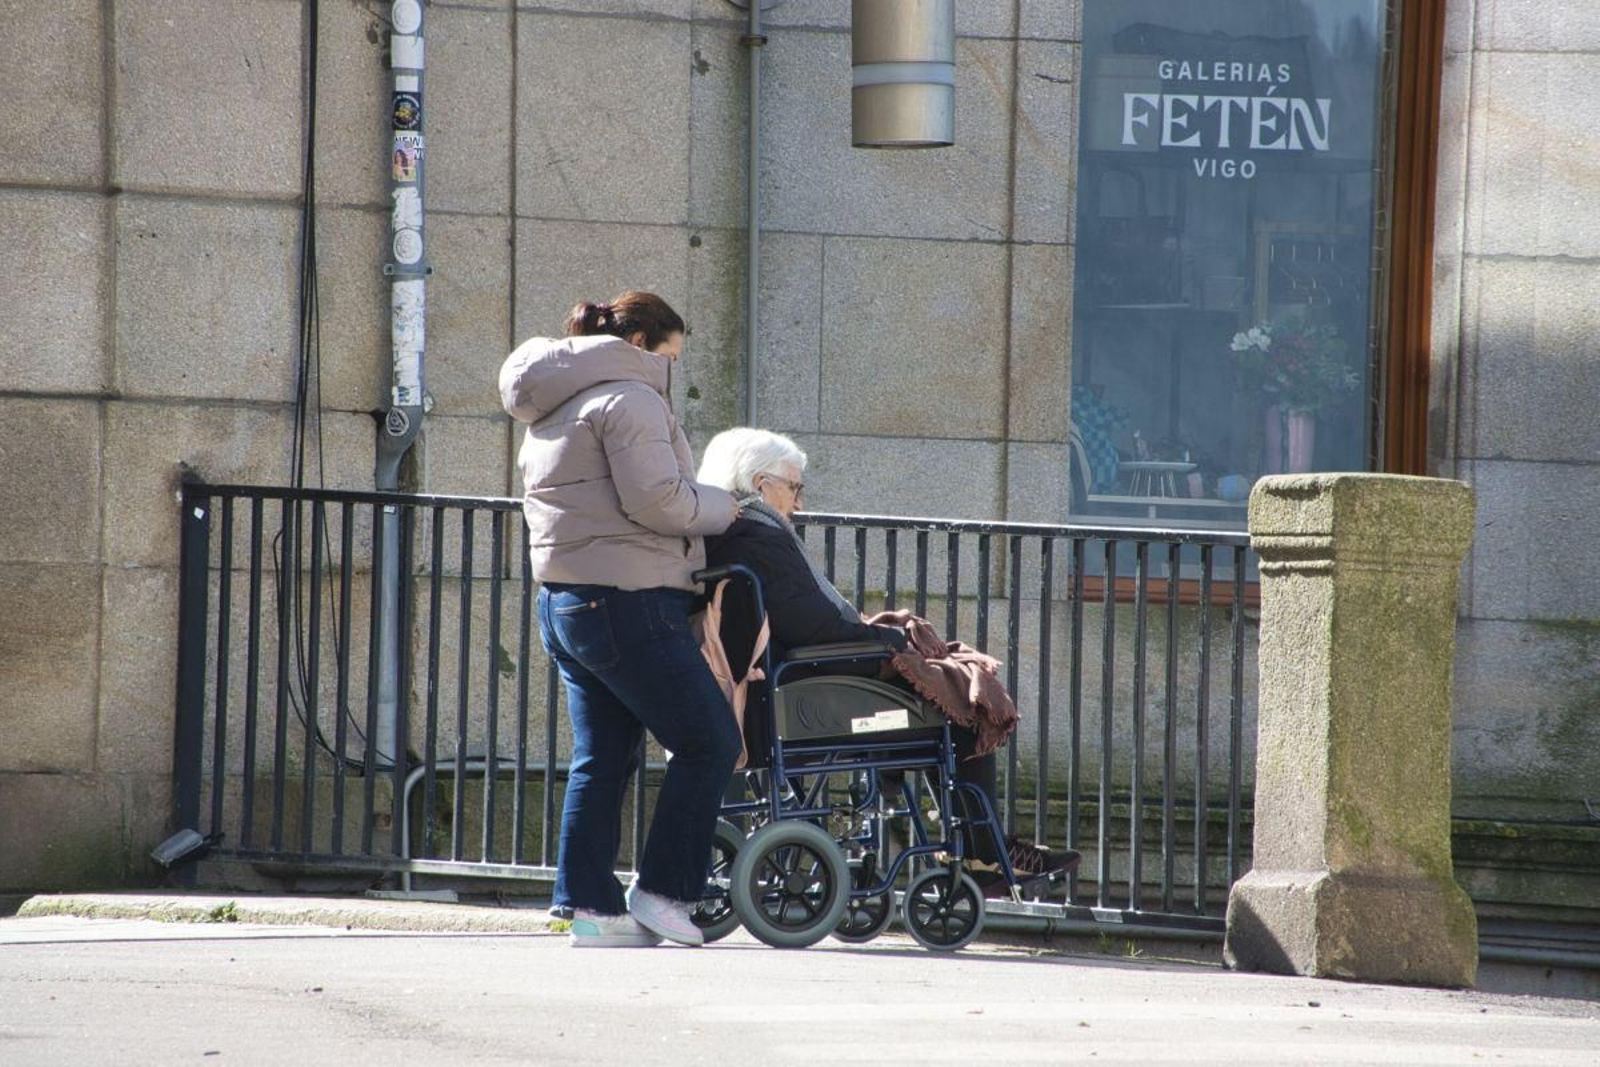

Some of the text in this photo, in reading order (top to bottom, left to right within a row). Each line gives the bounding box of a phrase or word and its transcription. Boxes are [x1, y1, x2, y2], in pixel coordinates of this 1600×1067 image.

[1158, 60, 1291, 82] GALERIAS
[1121, 85, 1332, 151] FETÉN
[1193, 158, 1257, 179] VIGO
